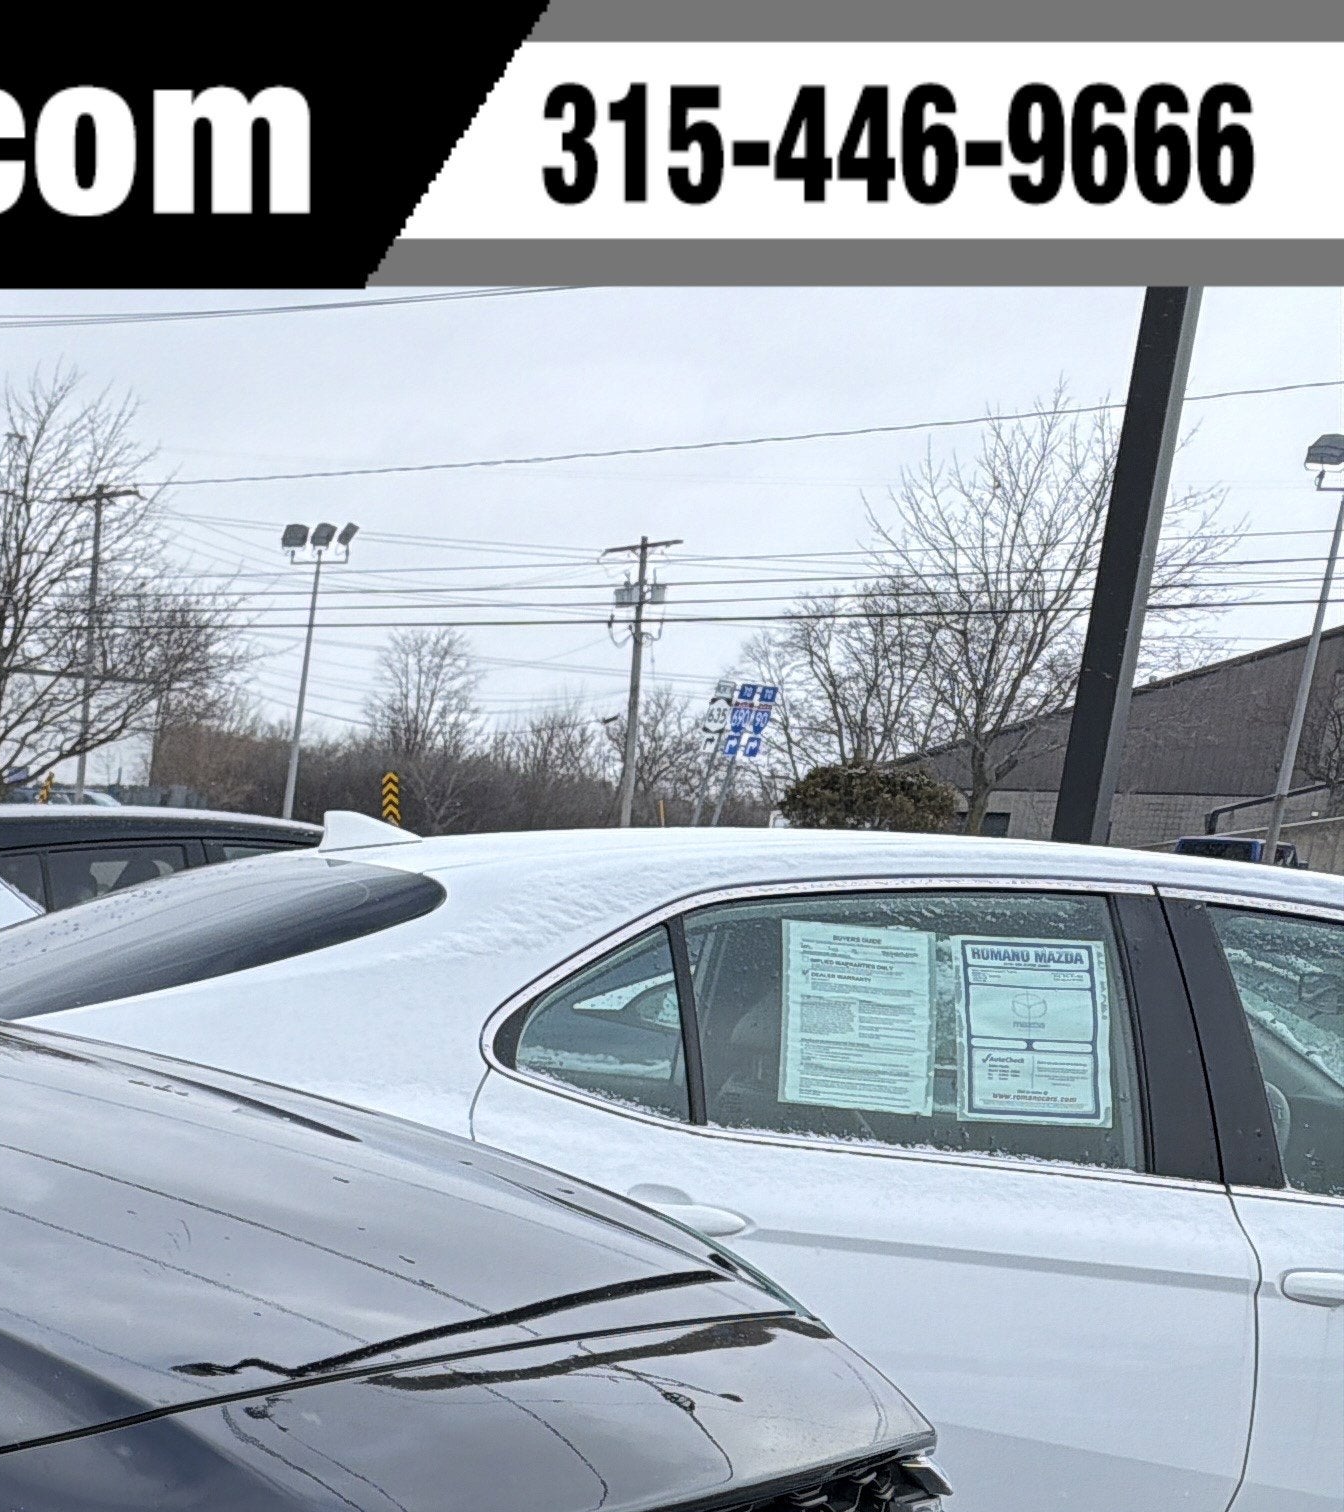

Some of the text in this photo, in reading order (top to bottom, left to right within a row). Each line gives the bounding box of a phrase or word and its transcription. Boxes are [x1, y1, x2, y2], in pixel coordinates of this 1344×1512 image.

[708, 708, 728, 723] 635
[732, 709, 751, 728] 690
[755, 711, 769, 728] 90
[833, 934, 883, 945] BUYERS GUIDE
[971, 946, 1085, 965] ROMANO MAZDA
[989, 1055, 1025, 1065] AutoCheck
